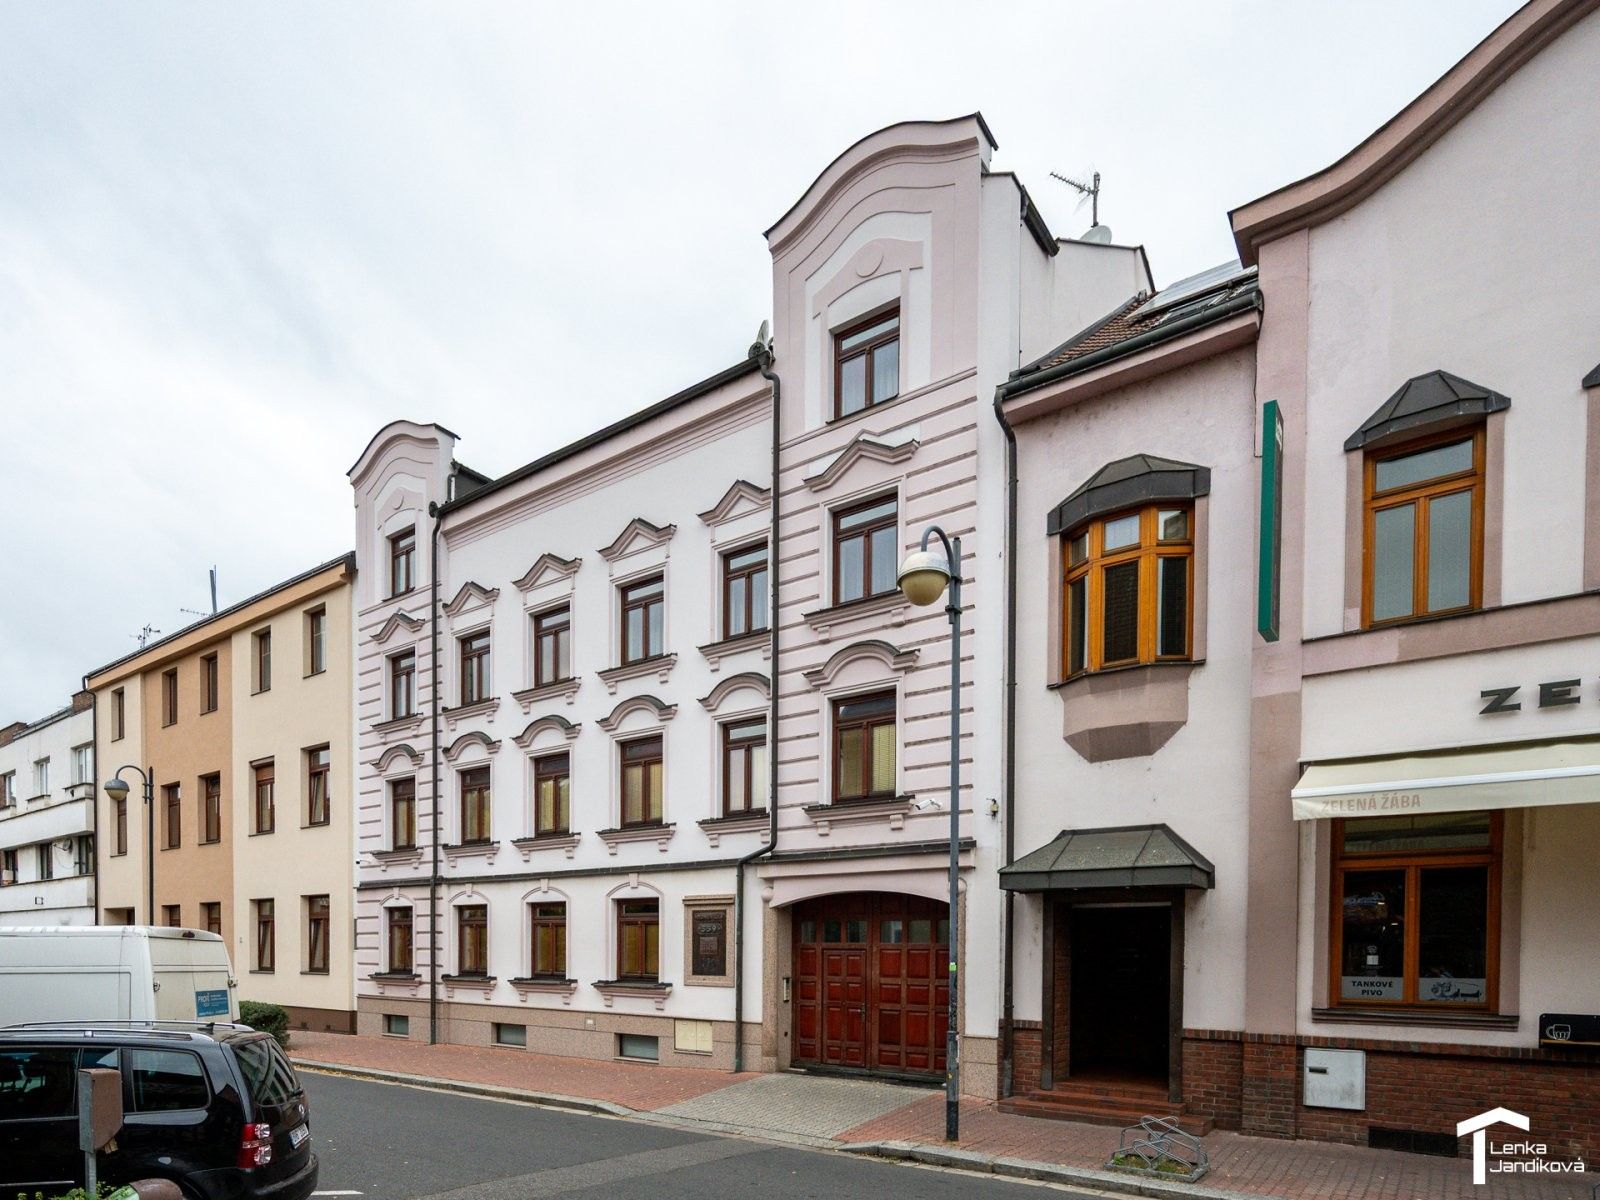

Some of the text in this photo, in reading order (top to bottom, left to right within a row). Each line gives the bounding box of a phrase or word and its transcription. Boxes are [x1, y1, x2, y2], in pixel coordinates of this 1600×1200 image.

[1479, 677, 1600, 715] ZE
[1321, 792, 1421, 812] ZELENÁ ŽÁBA
